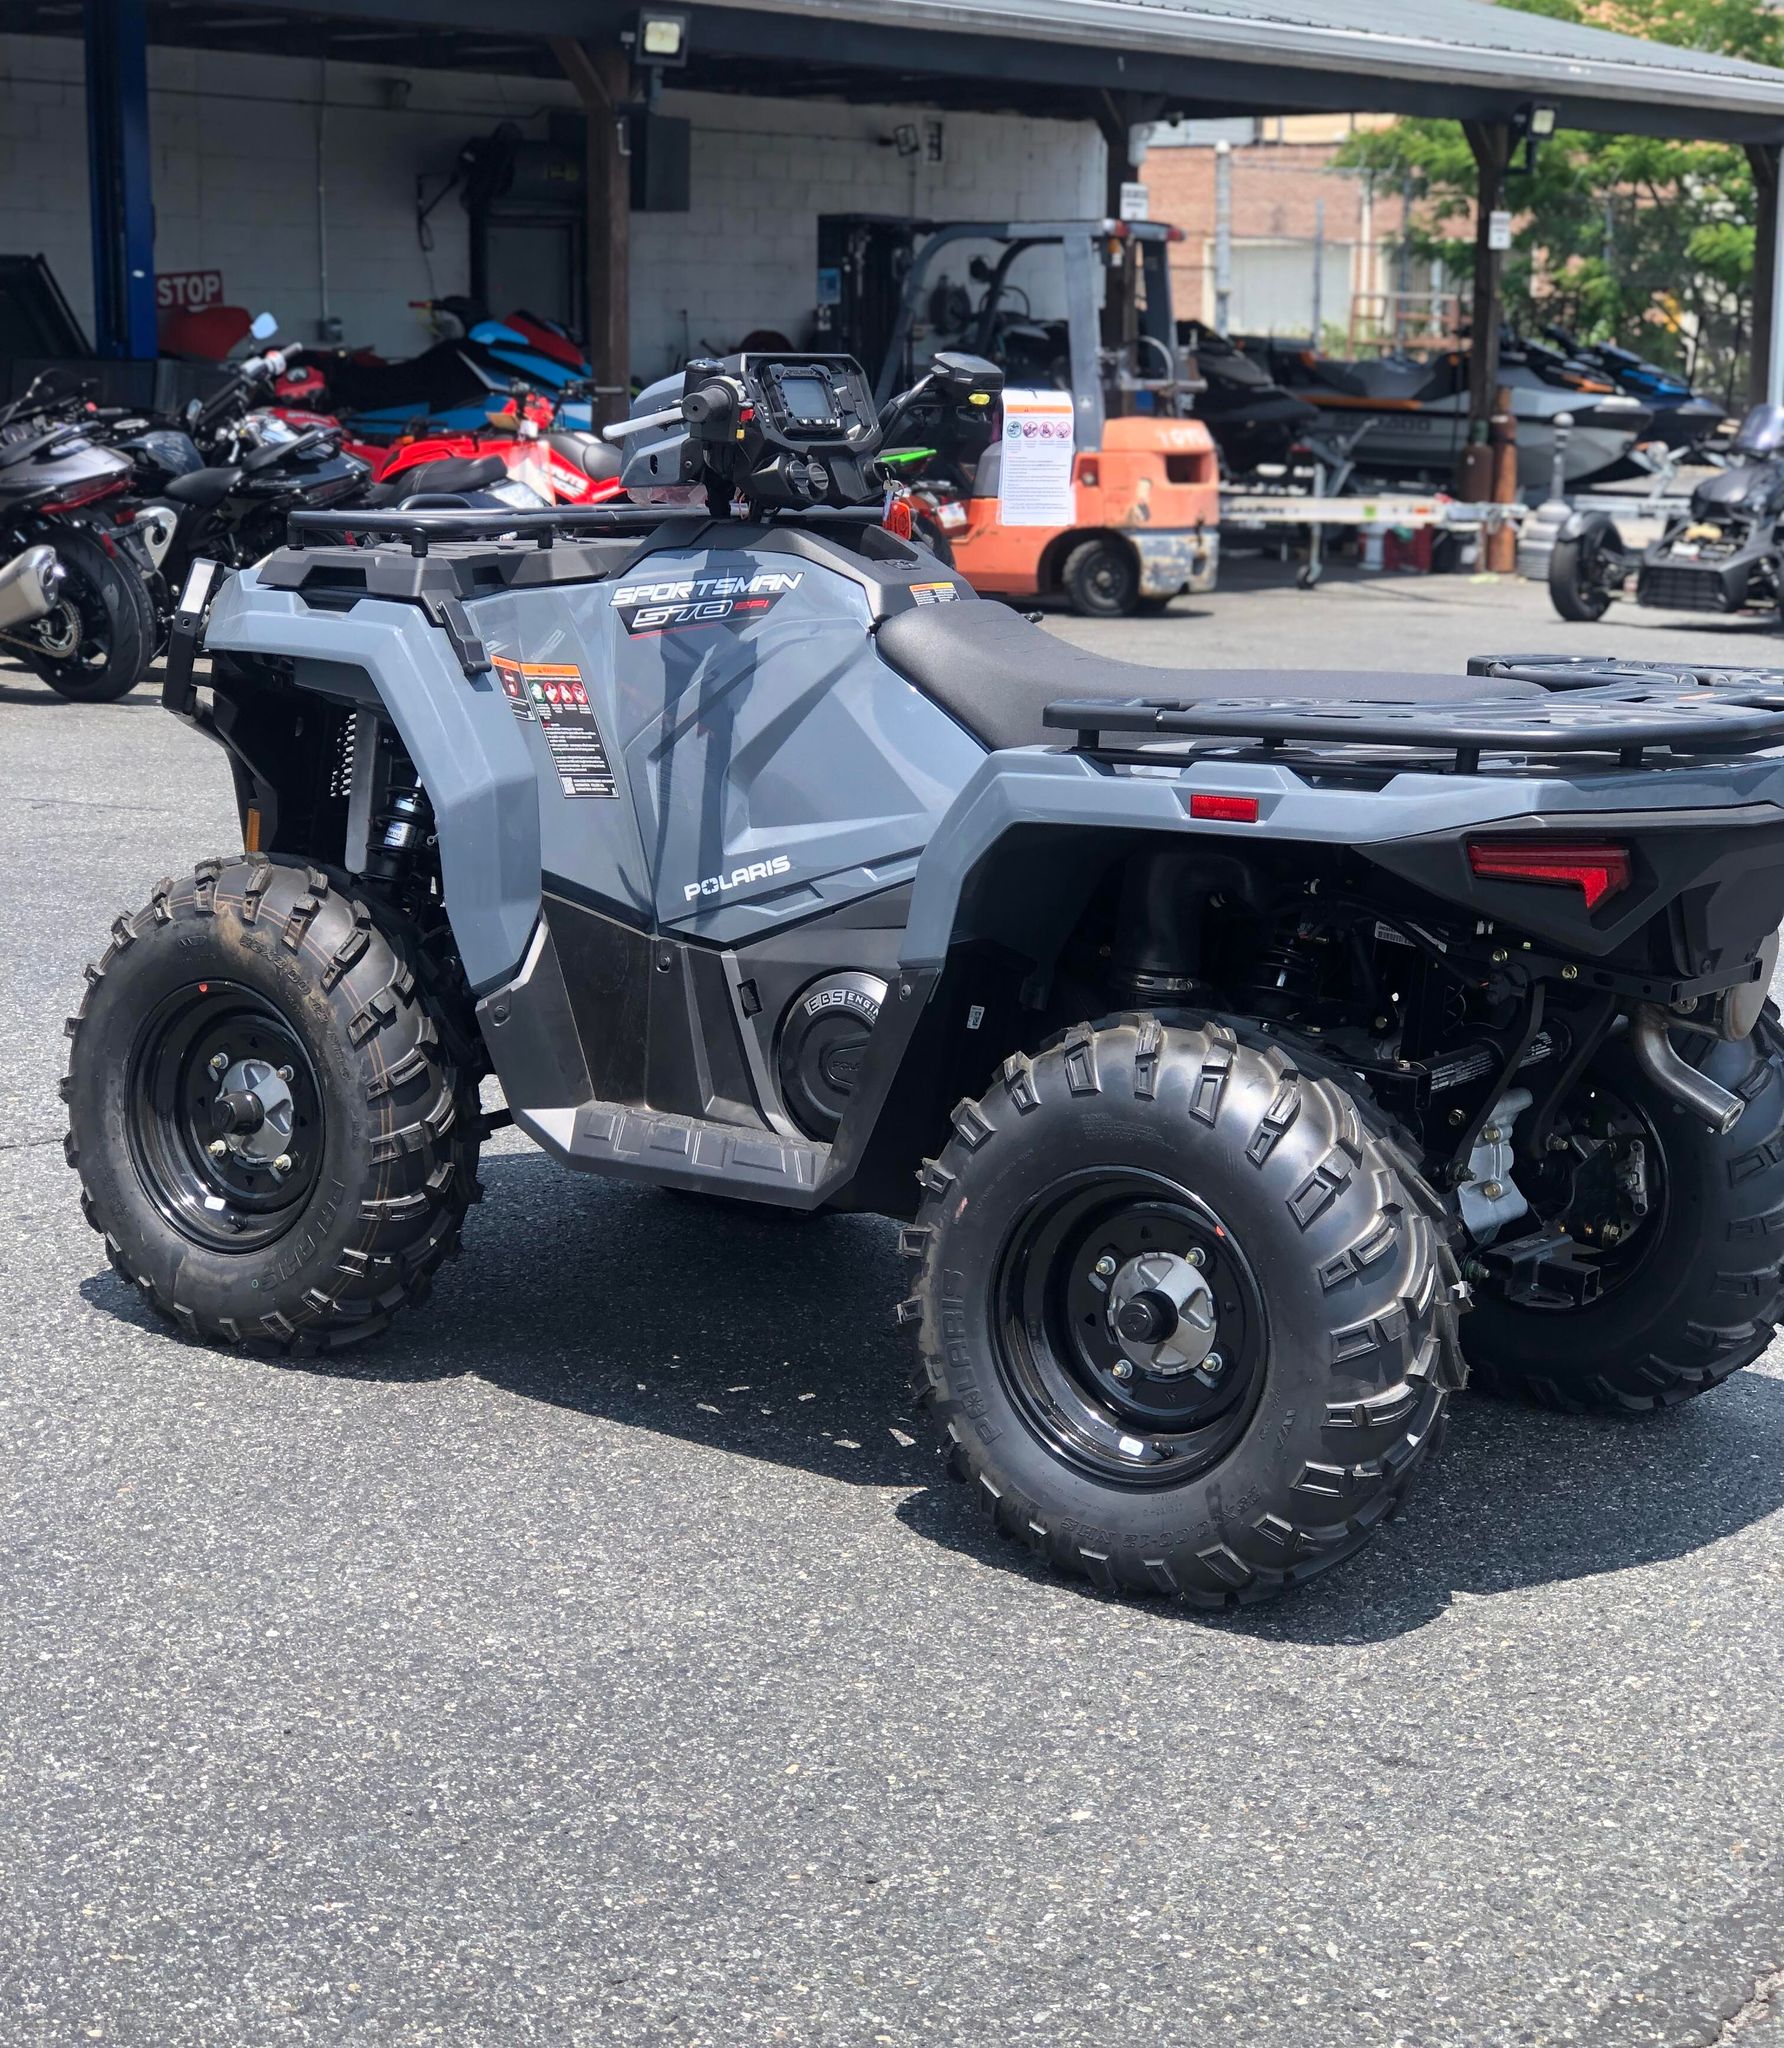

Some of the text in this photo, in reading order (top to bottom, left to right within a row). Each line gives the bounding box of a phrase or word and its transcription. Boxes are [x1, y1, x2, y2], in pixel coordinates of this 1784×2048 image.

[157, 274, 221, 306] STOP
[609, 572, 804, 606] SPORTSMAN
[631, 599, 733, 628] 570
[683, 855, 791, 902] POLARIS
[808, 990, 843, 1013] EBS
[941, 1268, 1004, 1446] POLARIS
